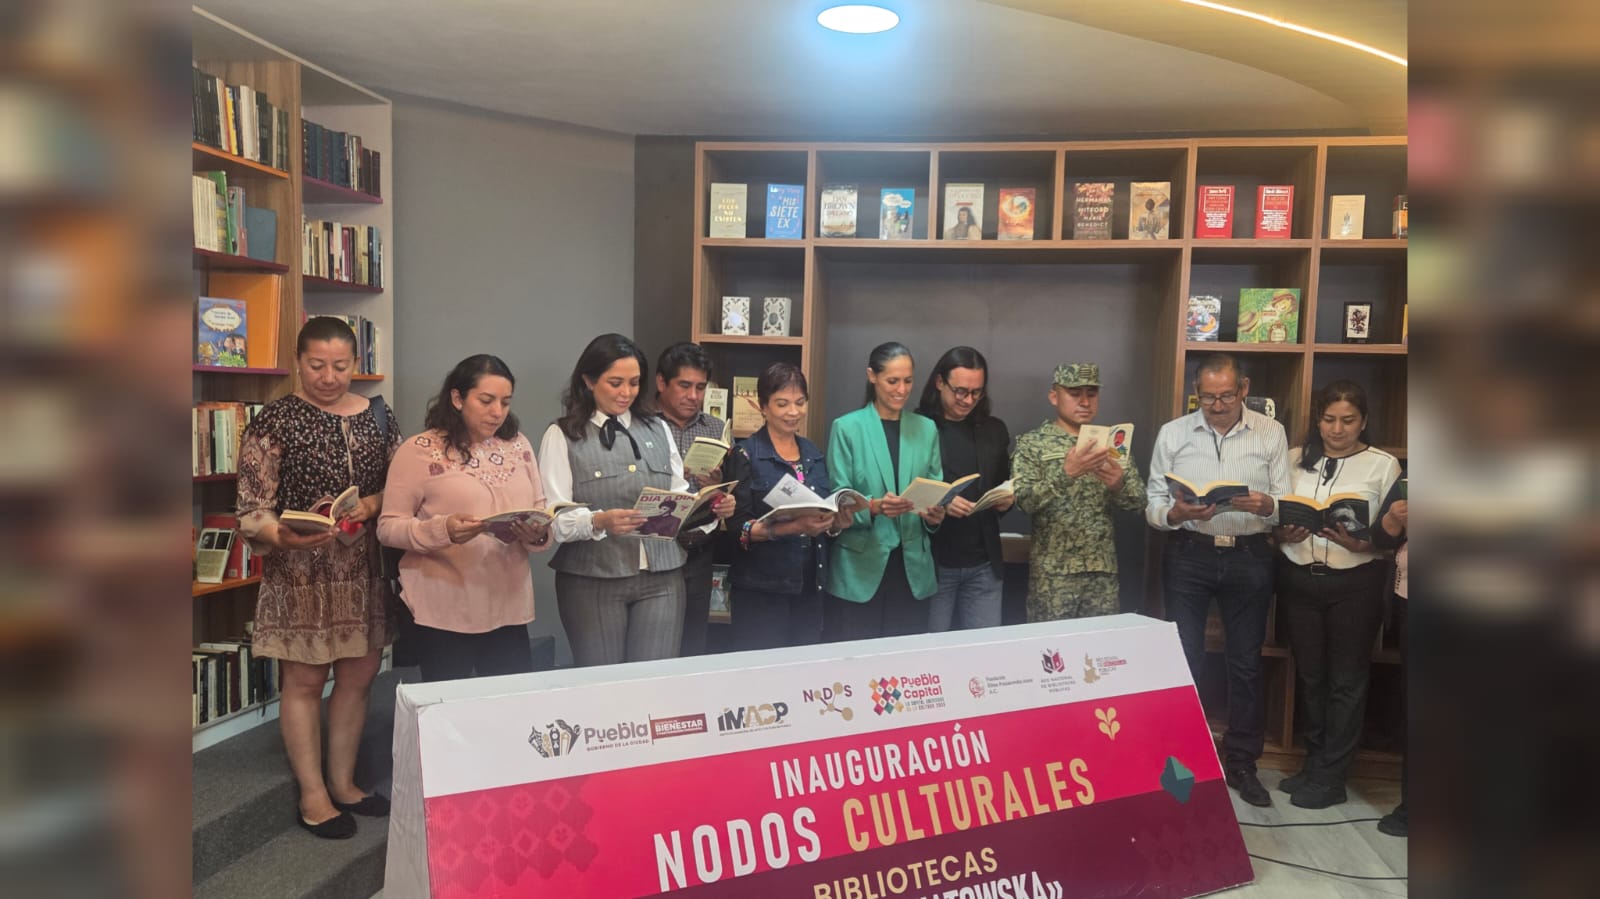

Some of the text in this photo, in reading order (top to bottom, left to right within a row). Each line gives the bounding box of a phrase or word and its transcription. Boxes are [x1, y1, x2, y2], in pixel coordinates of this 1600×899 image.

[770, 207, 799, 218] SIETE
[824, 202, 856, 210] BROWN
[777, 217, 790, 229] EX
[900, 673, 940, 688] Puebla
[904, 685, 943, 700] Capital
[584, 721, 649, 745] Puebla
[655, 719, 703, 732] BIENESTAR
[770, 723, 991, 799] INAUGURACIÓN
[653, 758, 1096, 893] NODOS CULTURALES
[814, 847, 998, 899] BIBLIOTECAS
